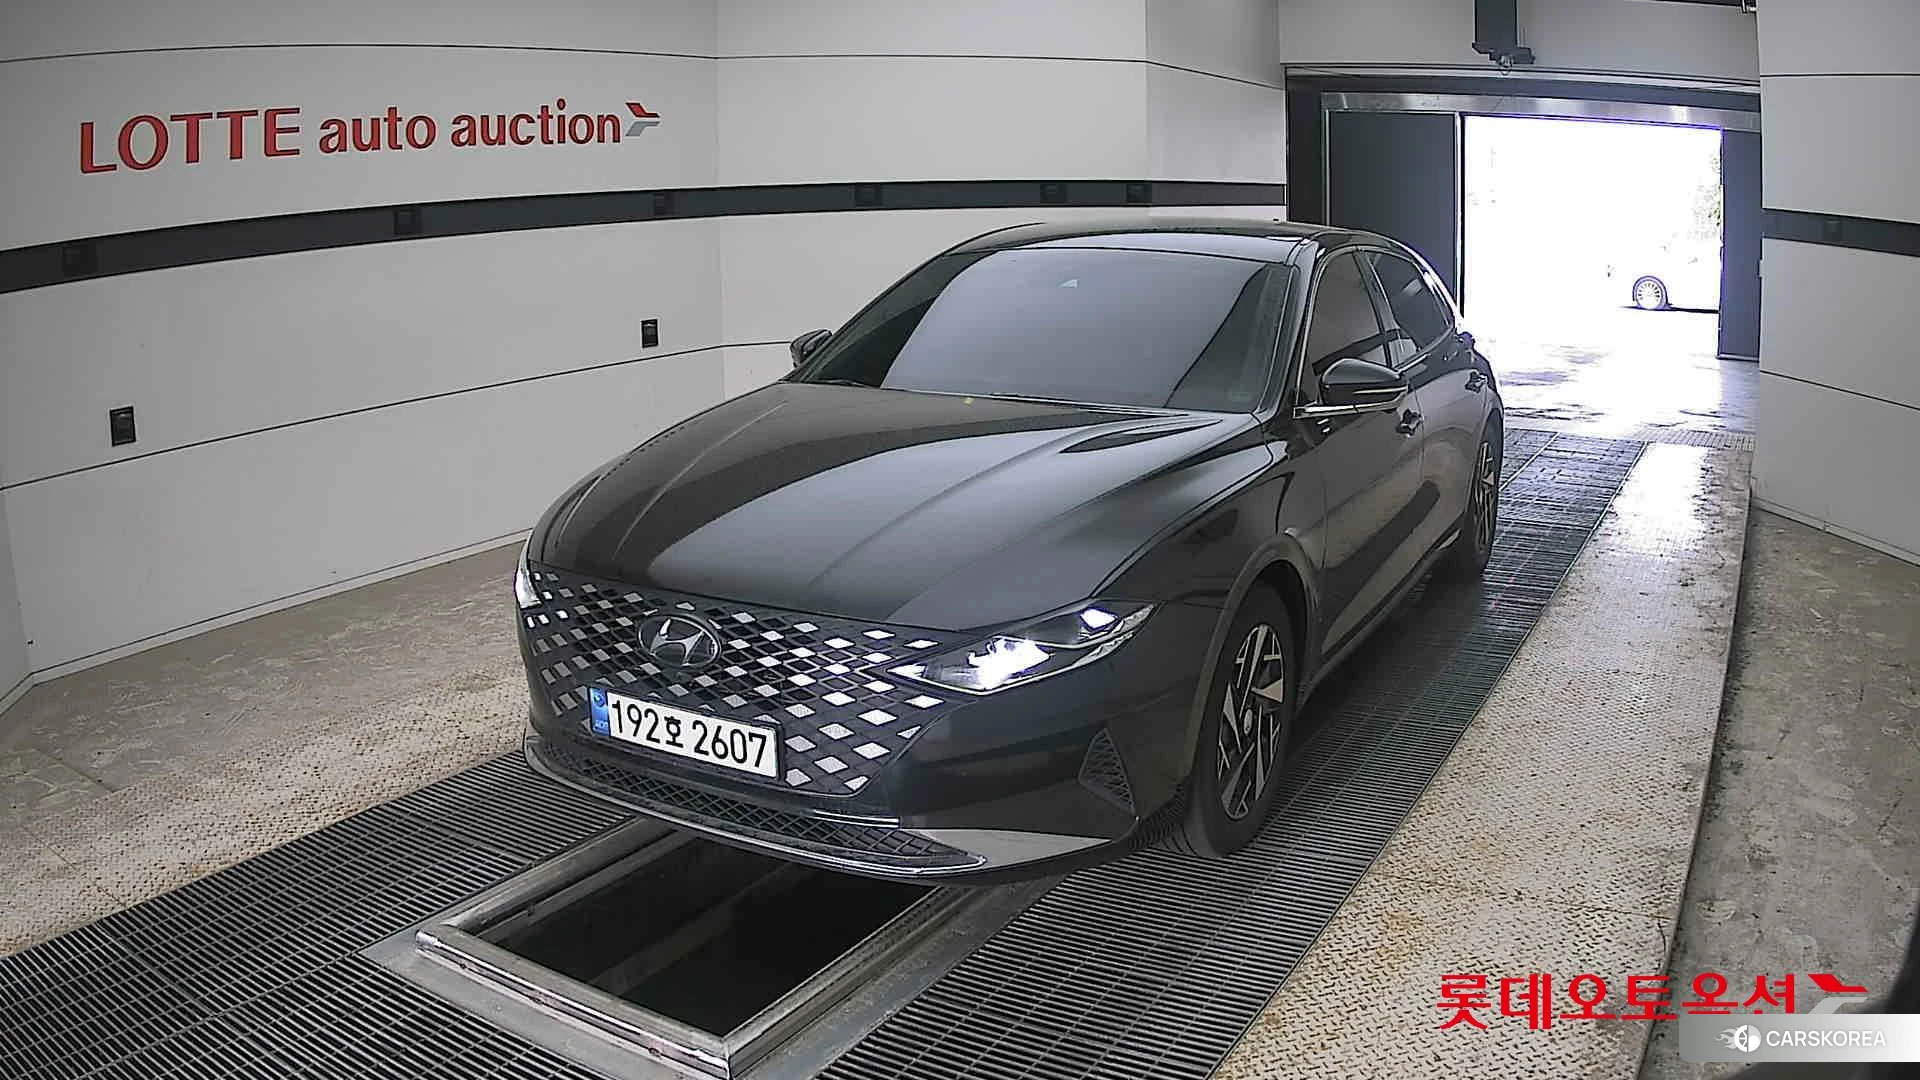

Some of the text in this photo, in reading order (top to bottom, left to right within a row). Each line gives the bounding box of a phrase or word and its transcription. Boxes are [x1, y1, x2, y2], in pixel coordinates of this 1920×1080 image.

[79, 98, 622, 174] LOTTE auto auction
[611, 700, 767, 767] 192호 2607
